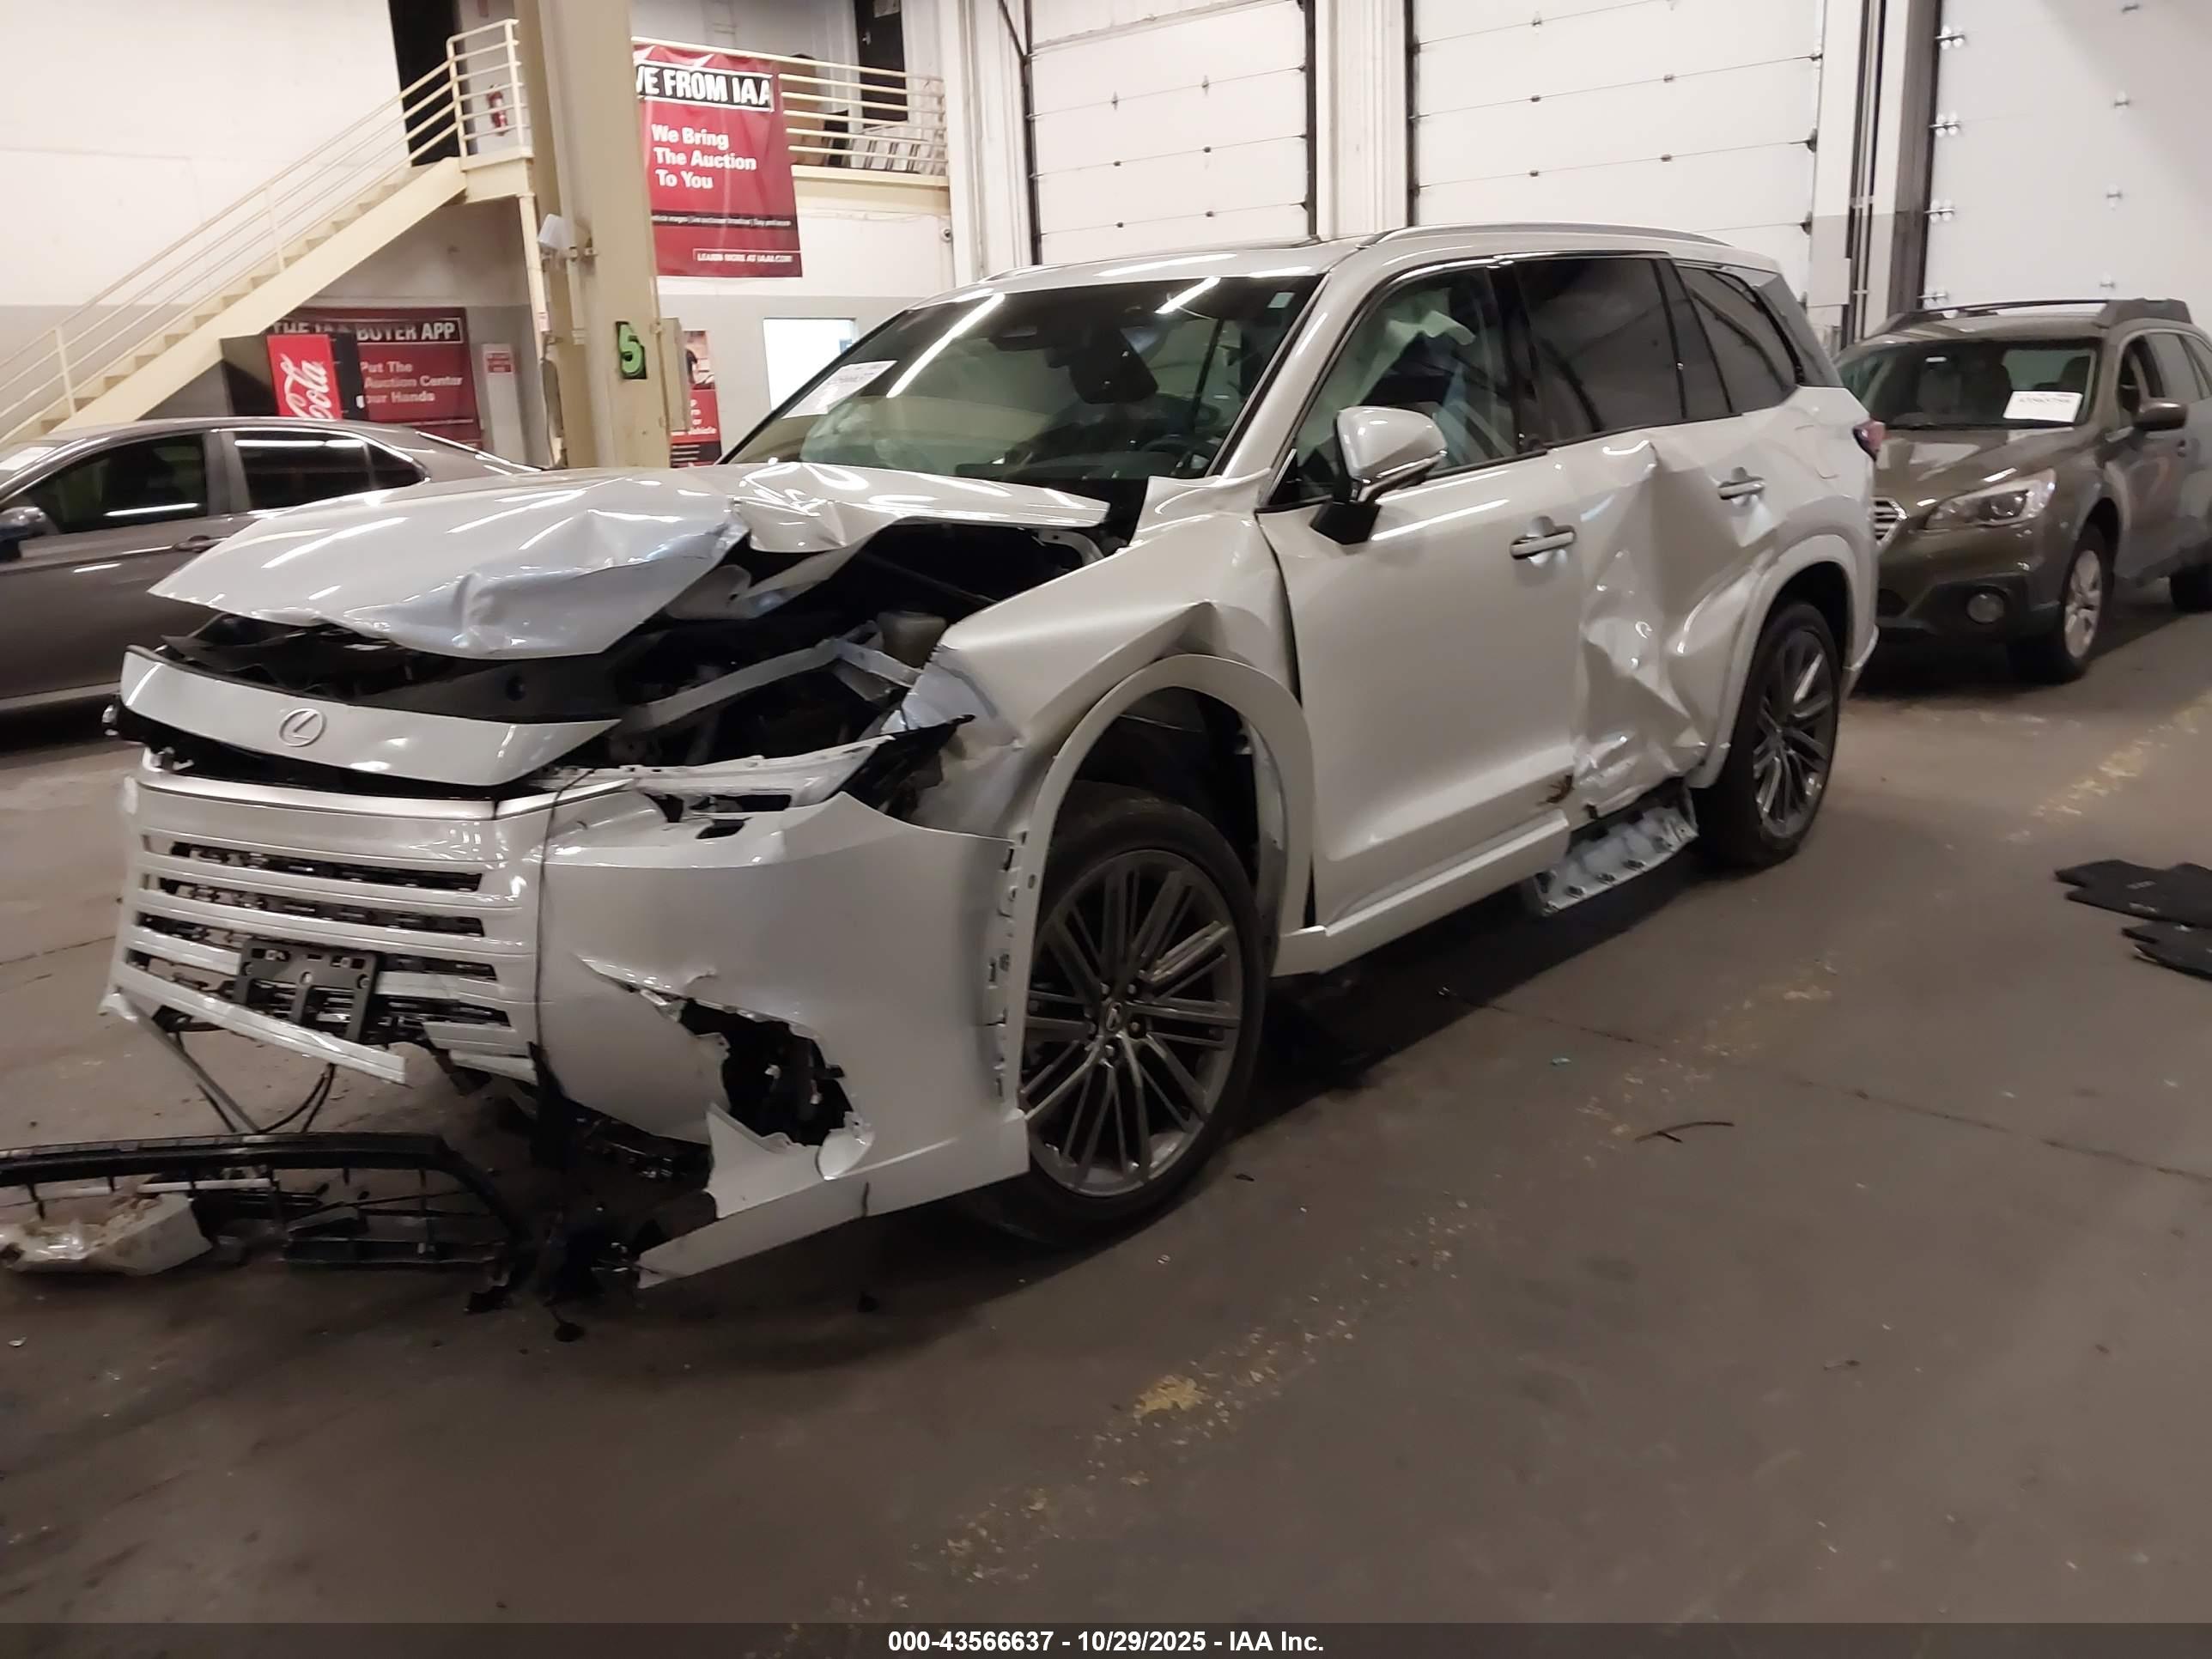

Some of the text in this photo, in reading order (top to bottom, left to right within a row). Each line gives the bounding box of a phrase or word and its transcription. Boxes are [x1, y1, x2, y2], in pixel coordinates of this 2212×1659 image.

[662, 69, 728, 102] FROM
[732, 76, 770, 106] IAA
[651, 124, 729, 150] We Bring
[653, 147, 757, 170] The Auction
[655, 168, 714, 189] To You
[421, 322, 455, 341] APP
[360, 361, 413, 373] Put The
[364, 374, 463, 388] Auction Center
[366, 390, 436, 404] our Hands
